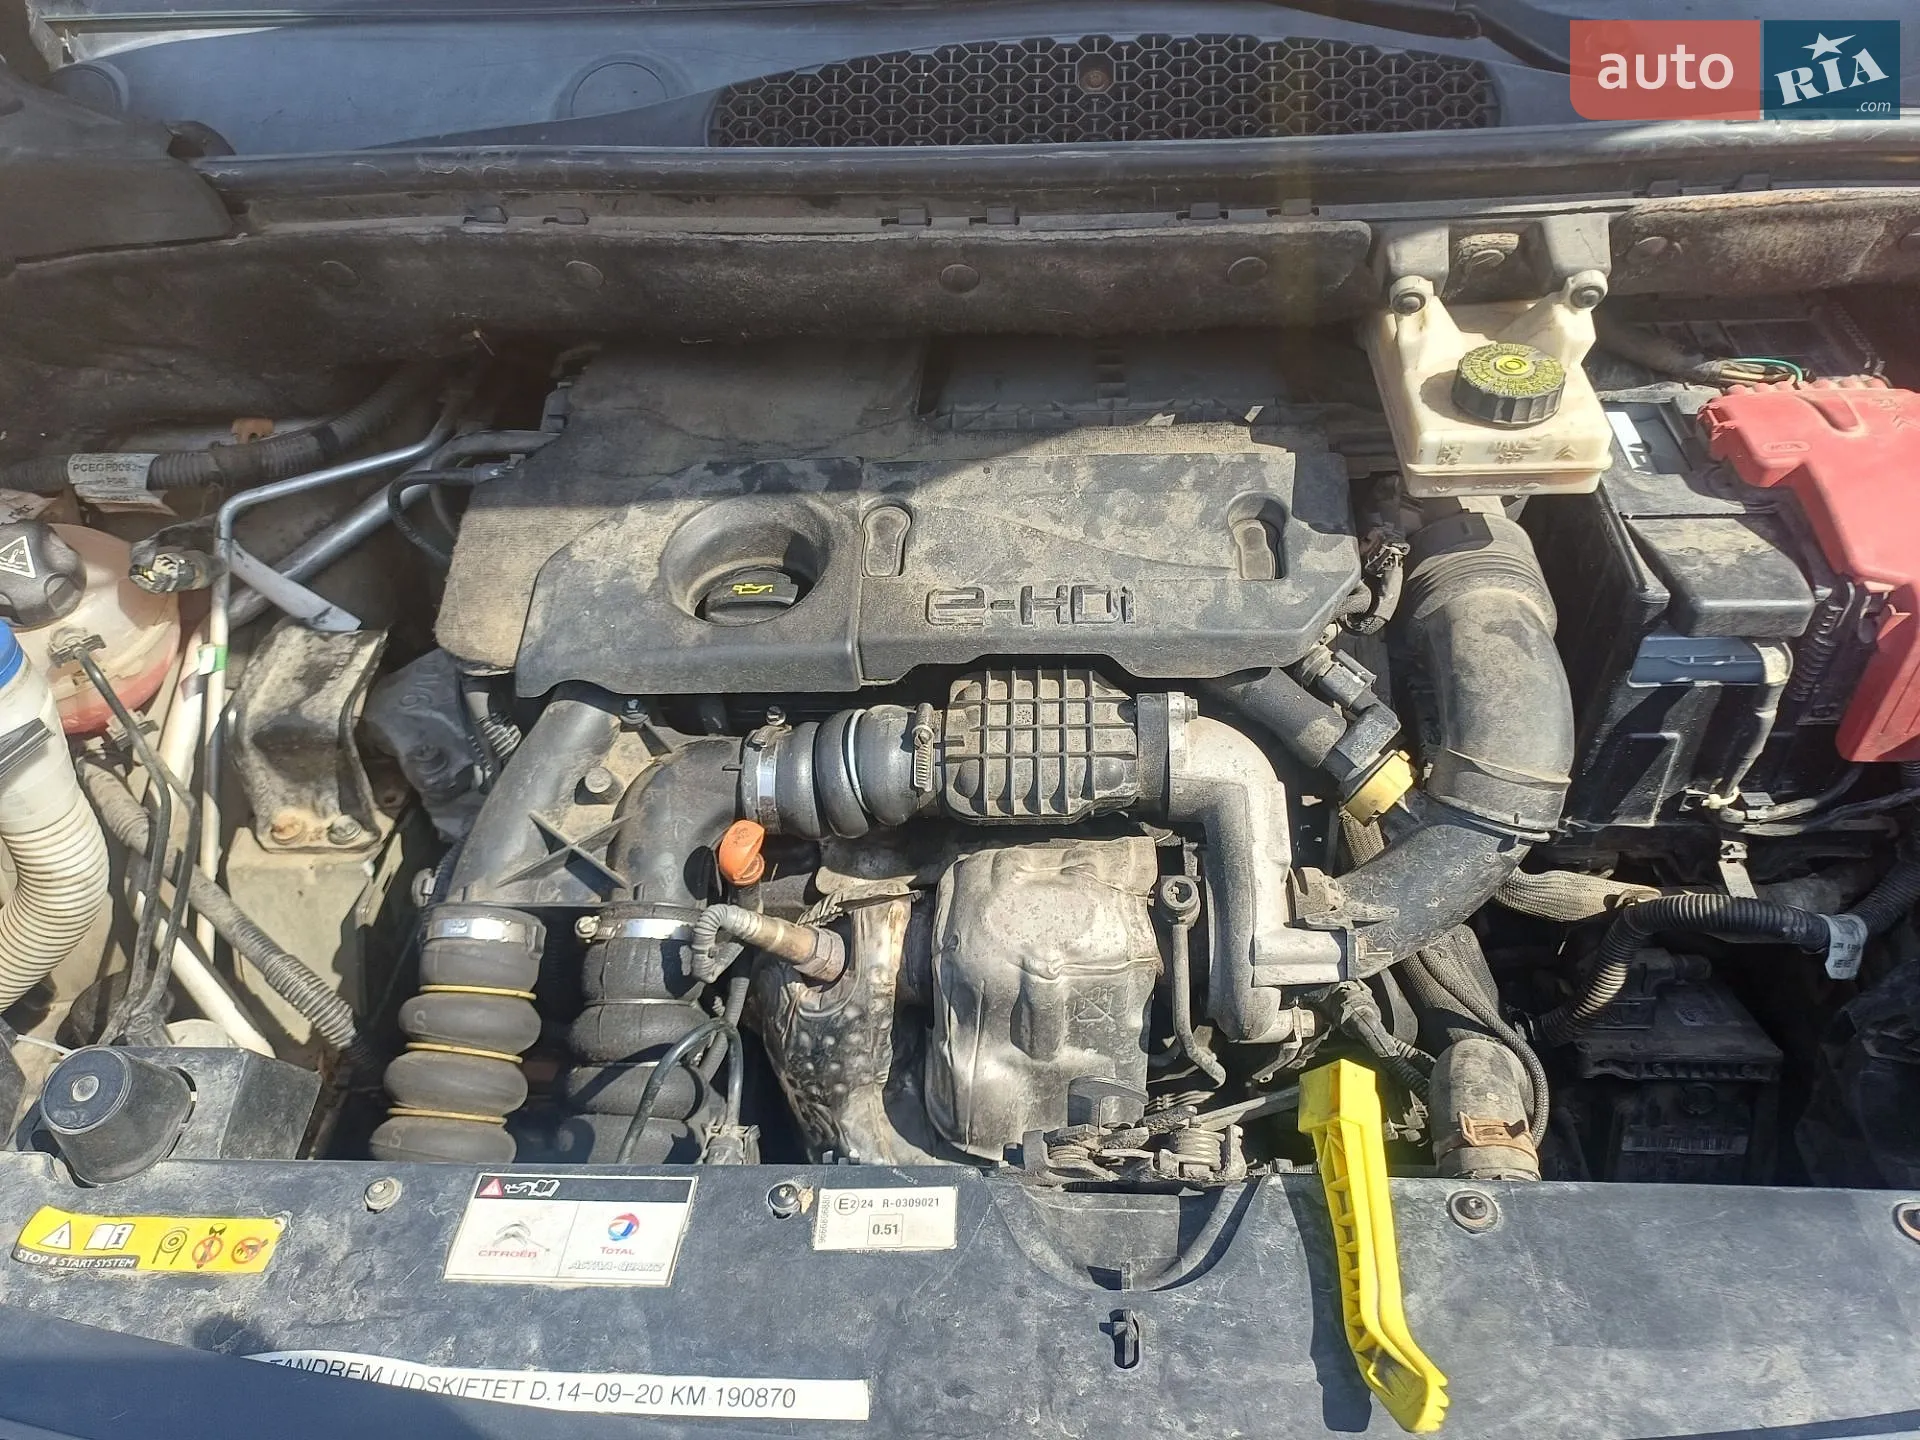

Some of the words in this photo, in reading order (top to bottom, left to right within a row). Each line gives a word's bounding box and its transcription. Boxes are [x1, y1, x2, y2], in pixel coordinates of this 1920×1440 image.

[882, 1197, 940, 1208] R-0309021
[872, 1223, 899, 1236] 0.51
[478, 1248, 537, 1259] CITROËN
[600, 1246, 635, 1256] TOTAL
[17, 1249, 48, 1265] STOP
[48, 1257, 57, 1267] &
[58, 1257, 95, 1268] START
[97, 1258, 136, 1268] SYSTEM
[670, 1385, 706, 1407] KM
[716, 1386, 796, 1408] 190870
